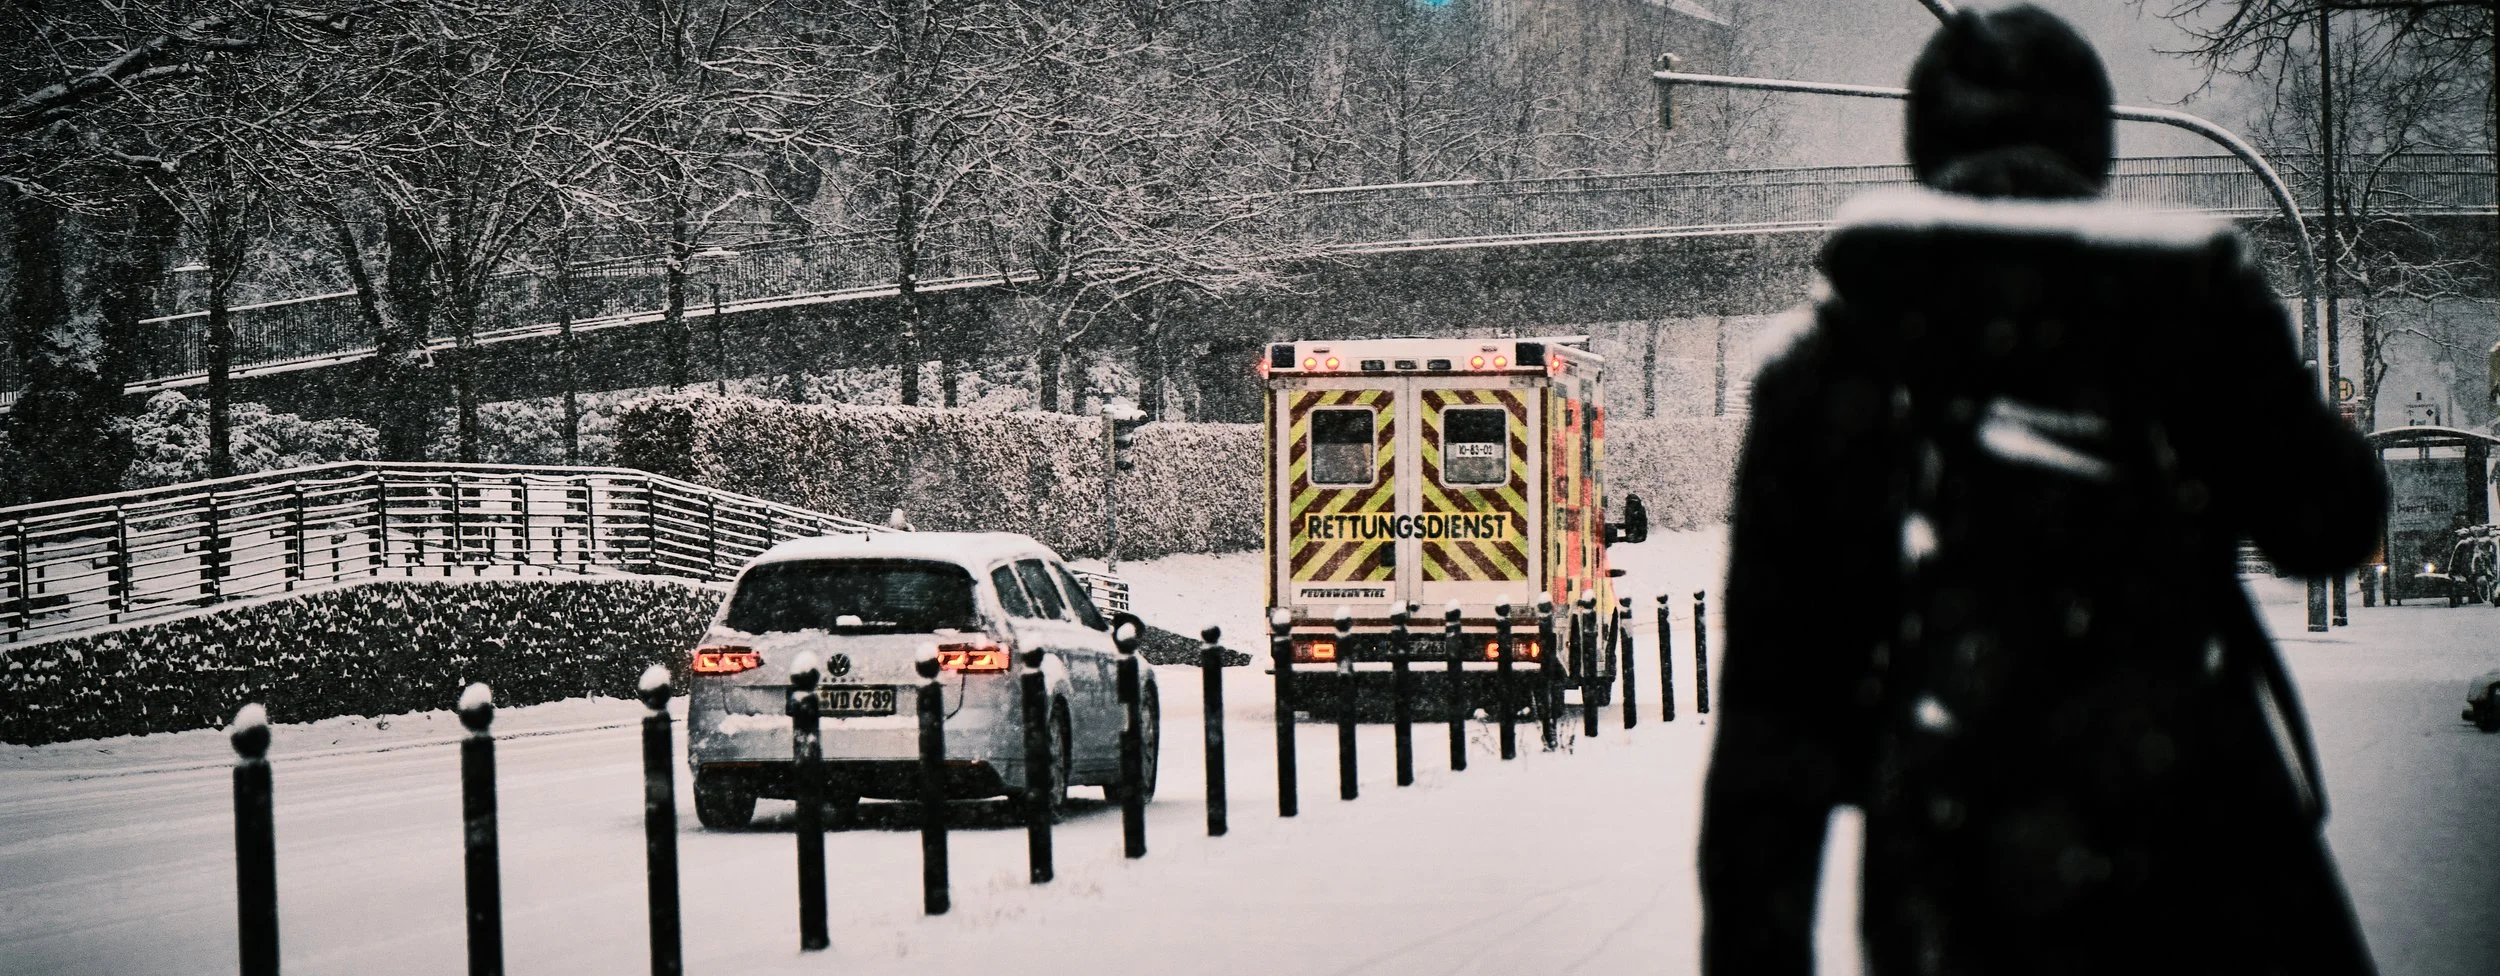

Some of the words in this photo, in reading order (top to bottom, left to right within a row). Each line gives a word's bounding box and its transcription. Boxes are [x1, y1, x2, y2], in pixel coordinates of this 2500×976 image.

[1308, 514, 1506, 539] RETTUNGSDIENST
[1300, 588, 1360, 598] FEUERWEHR
[1363, 588, 1386, 598] KIEL
[830, 691, 850, 709] VD
[853, 691, 892, 709] 6789
